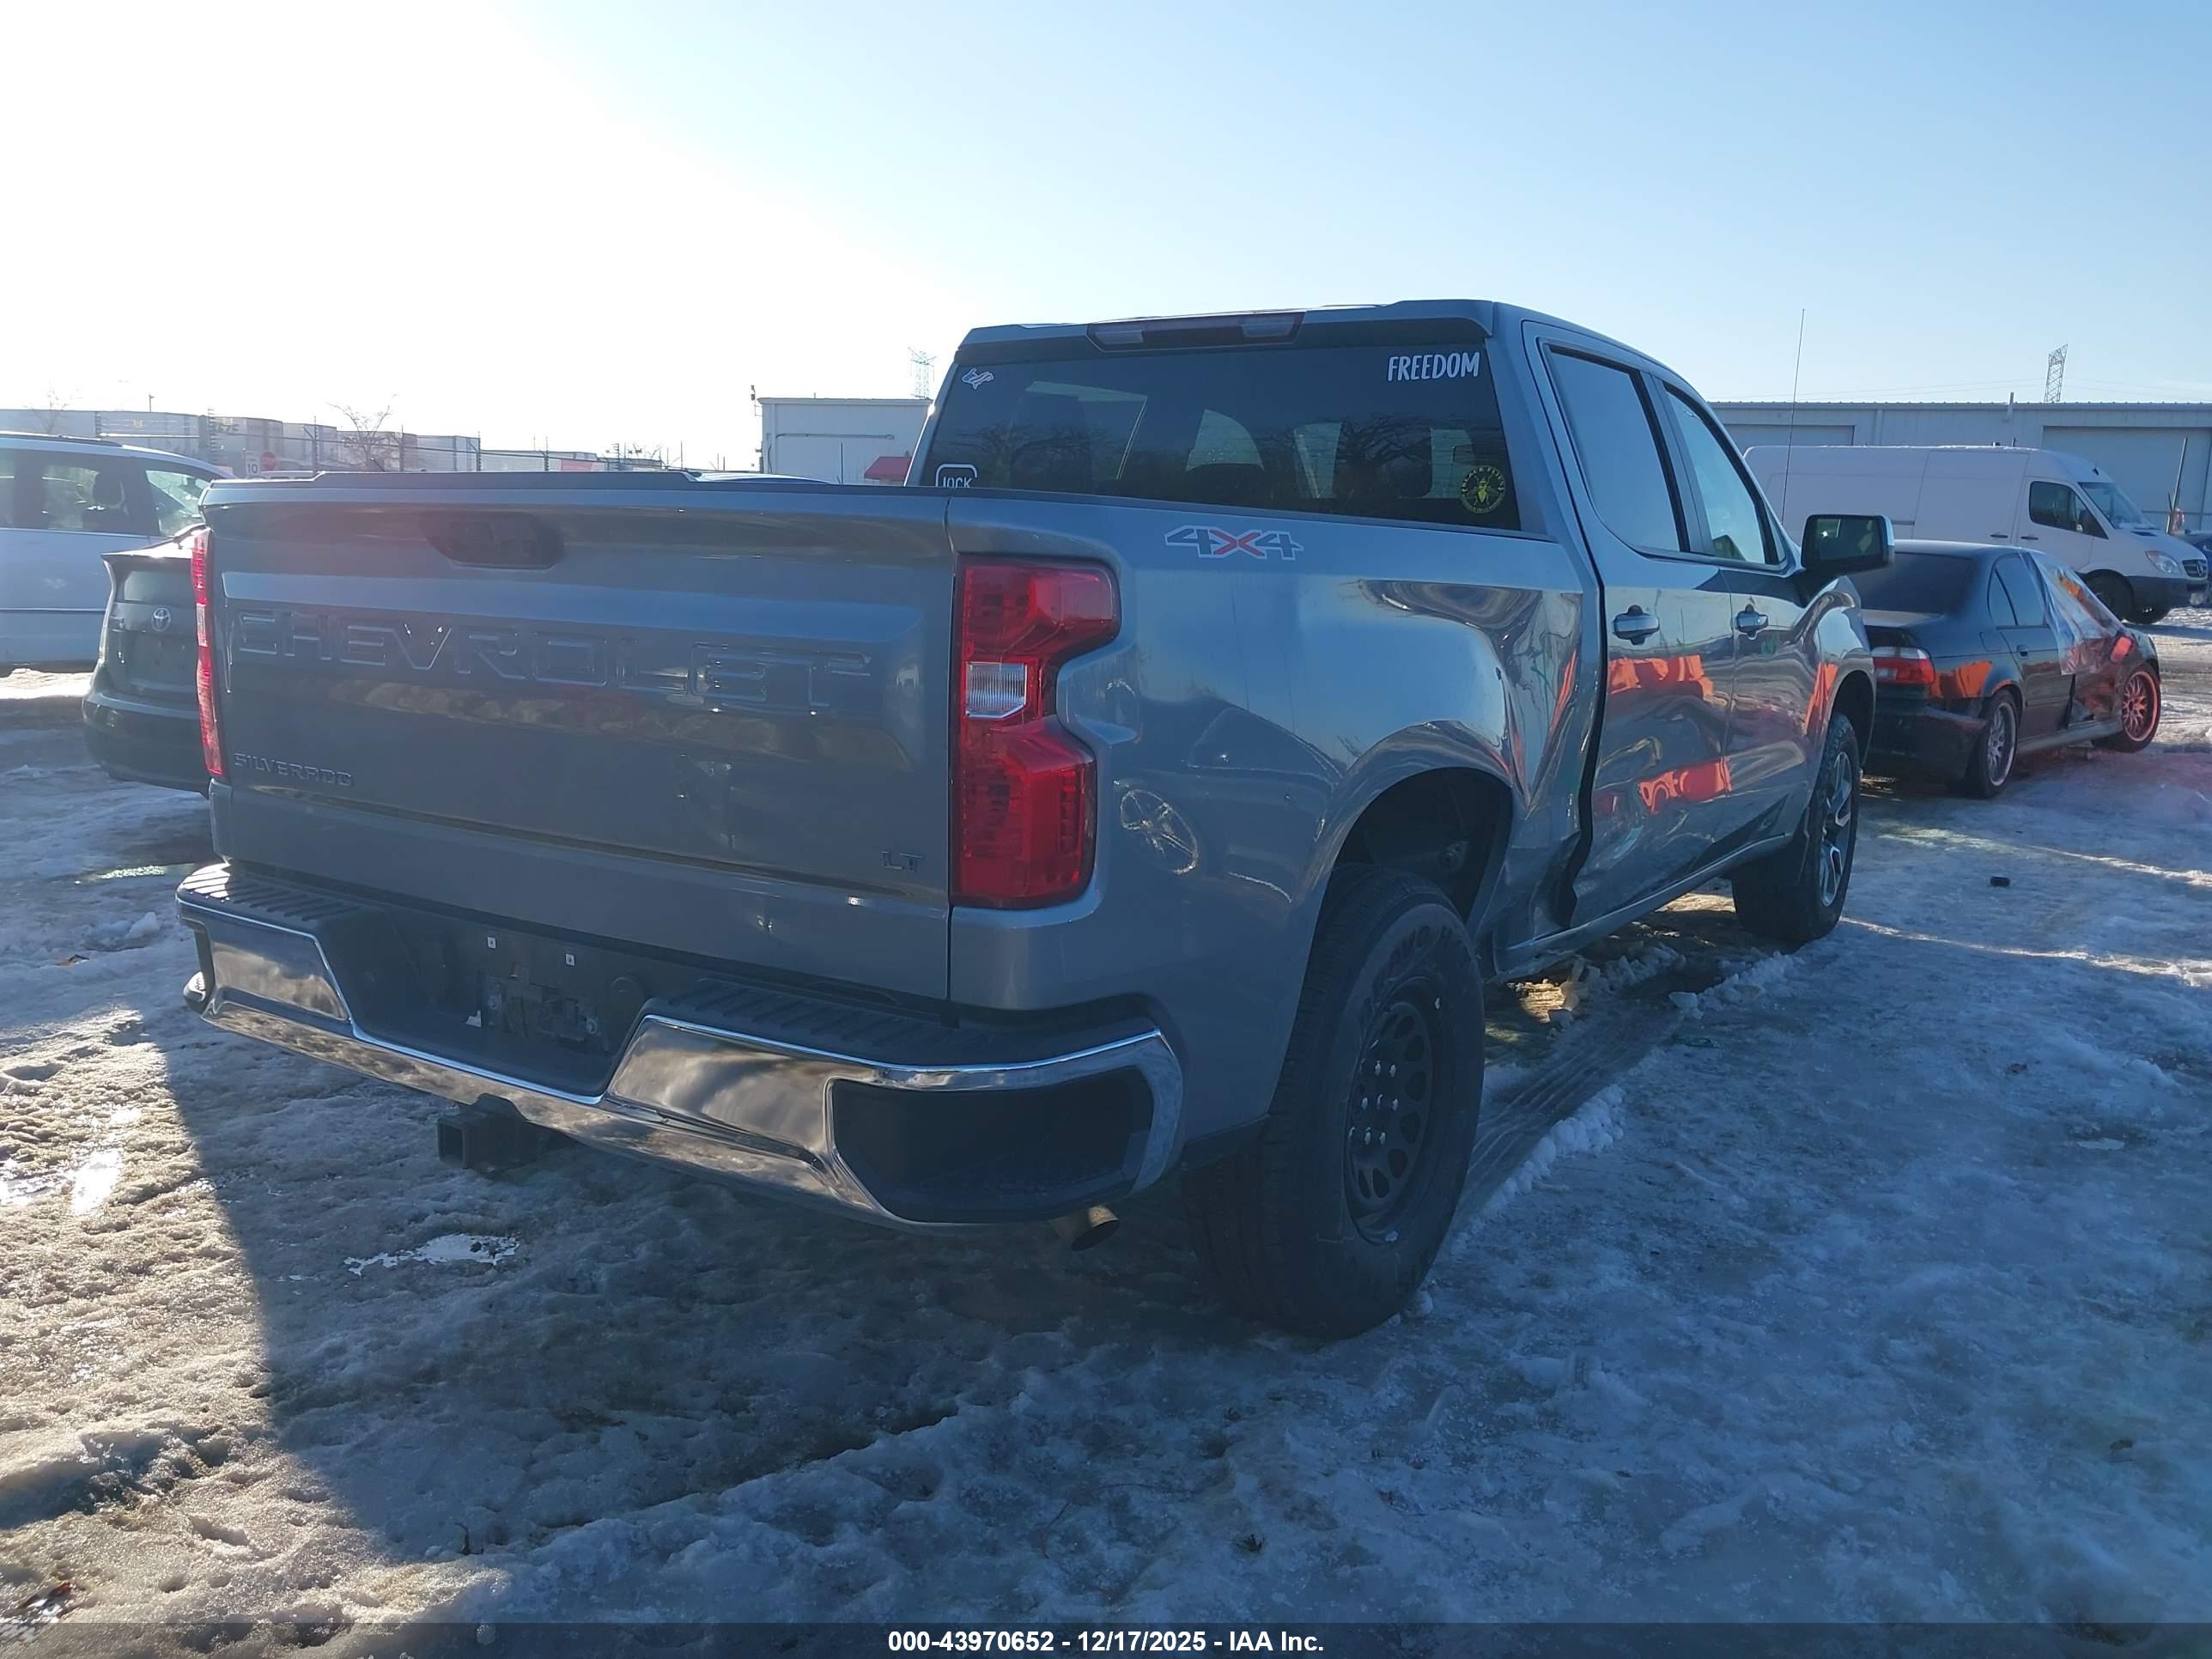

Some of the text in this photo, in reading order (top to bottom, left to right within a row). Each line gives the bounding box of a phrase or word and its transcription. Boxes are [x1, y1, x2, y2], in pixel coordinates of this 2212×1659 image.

[1388, 351, 1480, 381] FREEDOM
[247, 464, 258, 473] 10
[238, 611, 873, 711] CHEVROLET
[234, 753, 352, 786] SILVERADO
[880, 850, 924, 872] LT
